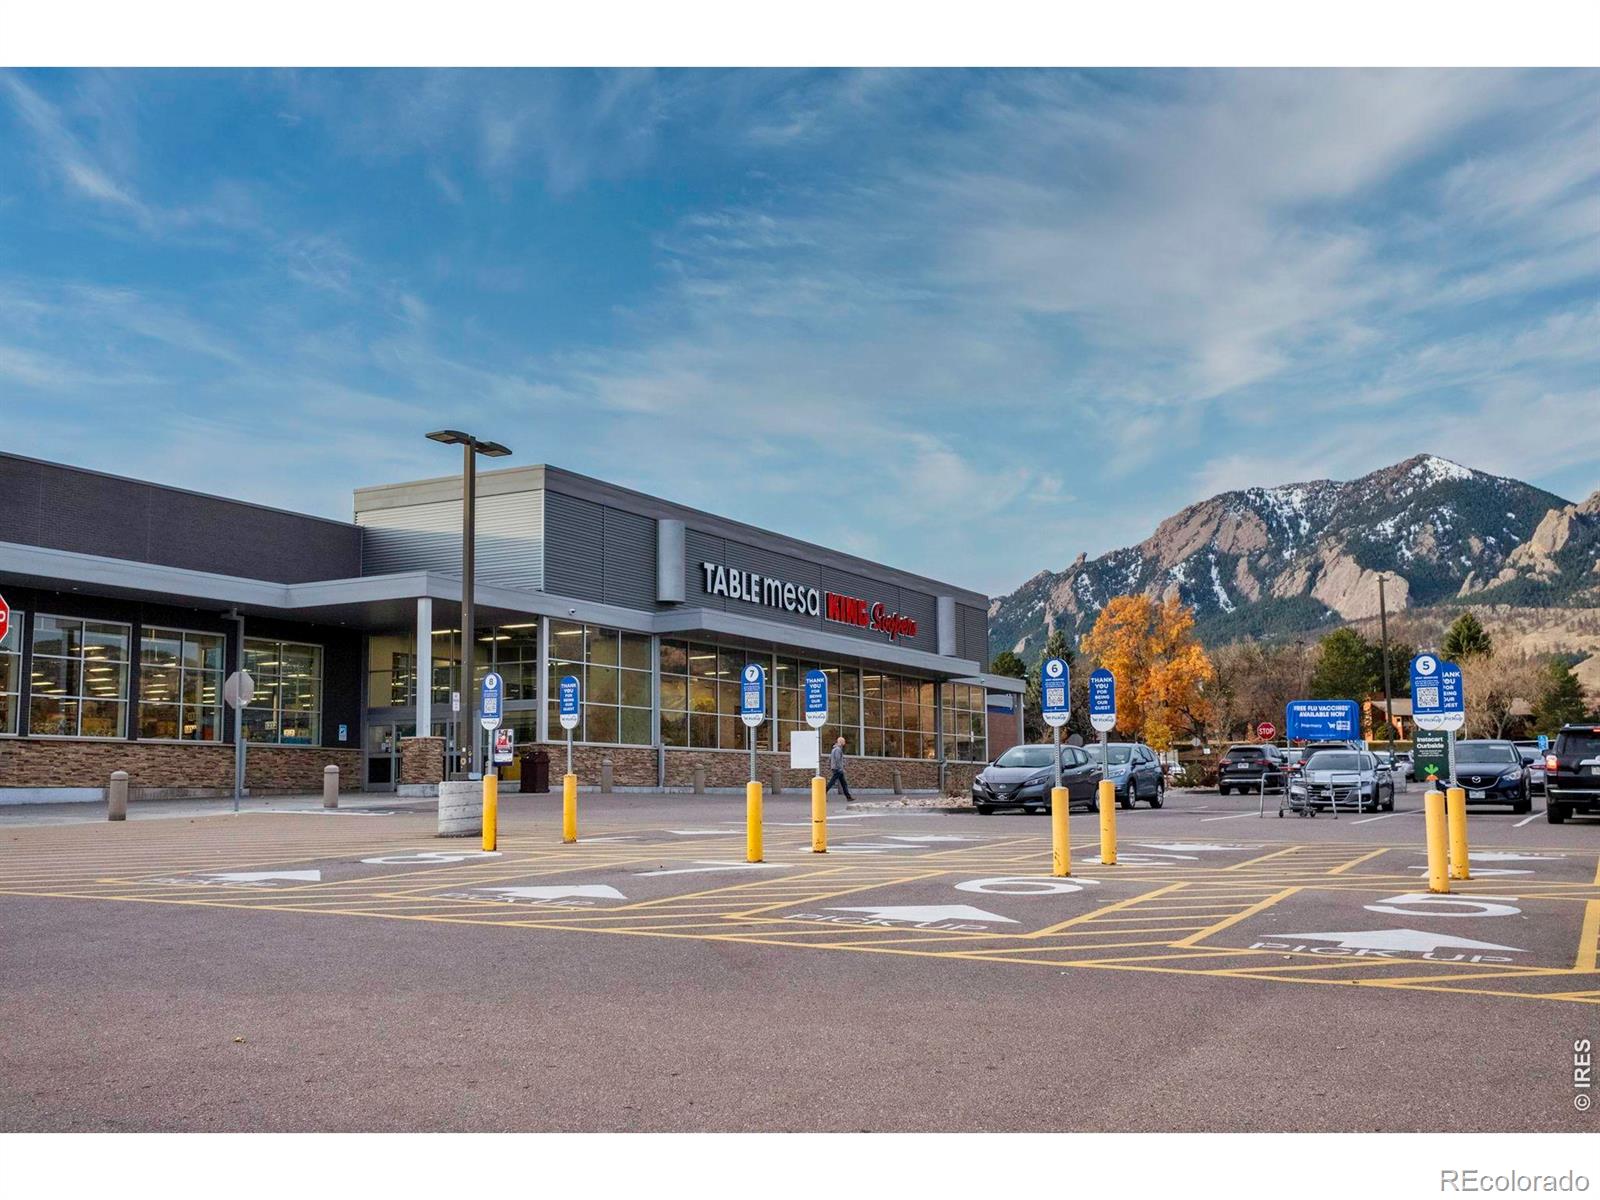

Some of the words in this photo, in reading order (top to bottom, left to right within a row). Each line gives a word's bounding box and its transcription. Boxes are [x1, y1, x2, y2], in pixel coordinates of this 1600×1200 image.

[704, 562, 760, 603] TABLE
[763, 577, 820, 616] mesa
[825, 591, 870, 628] KING
[749, 670, 754, 678] 7
[1051, 664, 1058, 673] 6
[1422, 661, 1430, 670] 5
[488, 678, 494, 686] 8
[954, 876, 1101, 895] 6
[1363, 893, 1522, 918] 5
[783, 912, 904, 927] PICK
[914, 922, 989, 931] UP
[1248, 942, 1402, 957] PICK
[1422, 951, 1514, 963] UP
